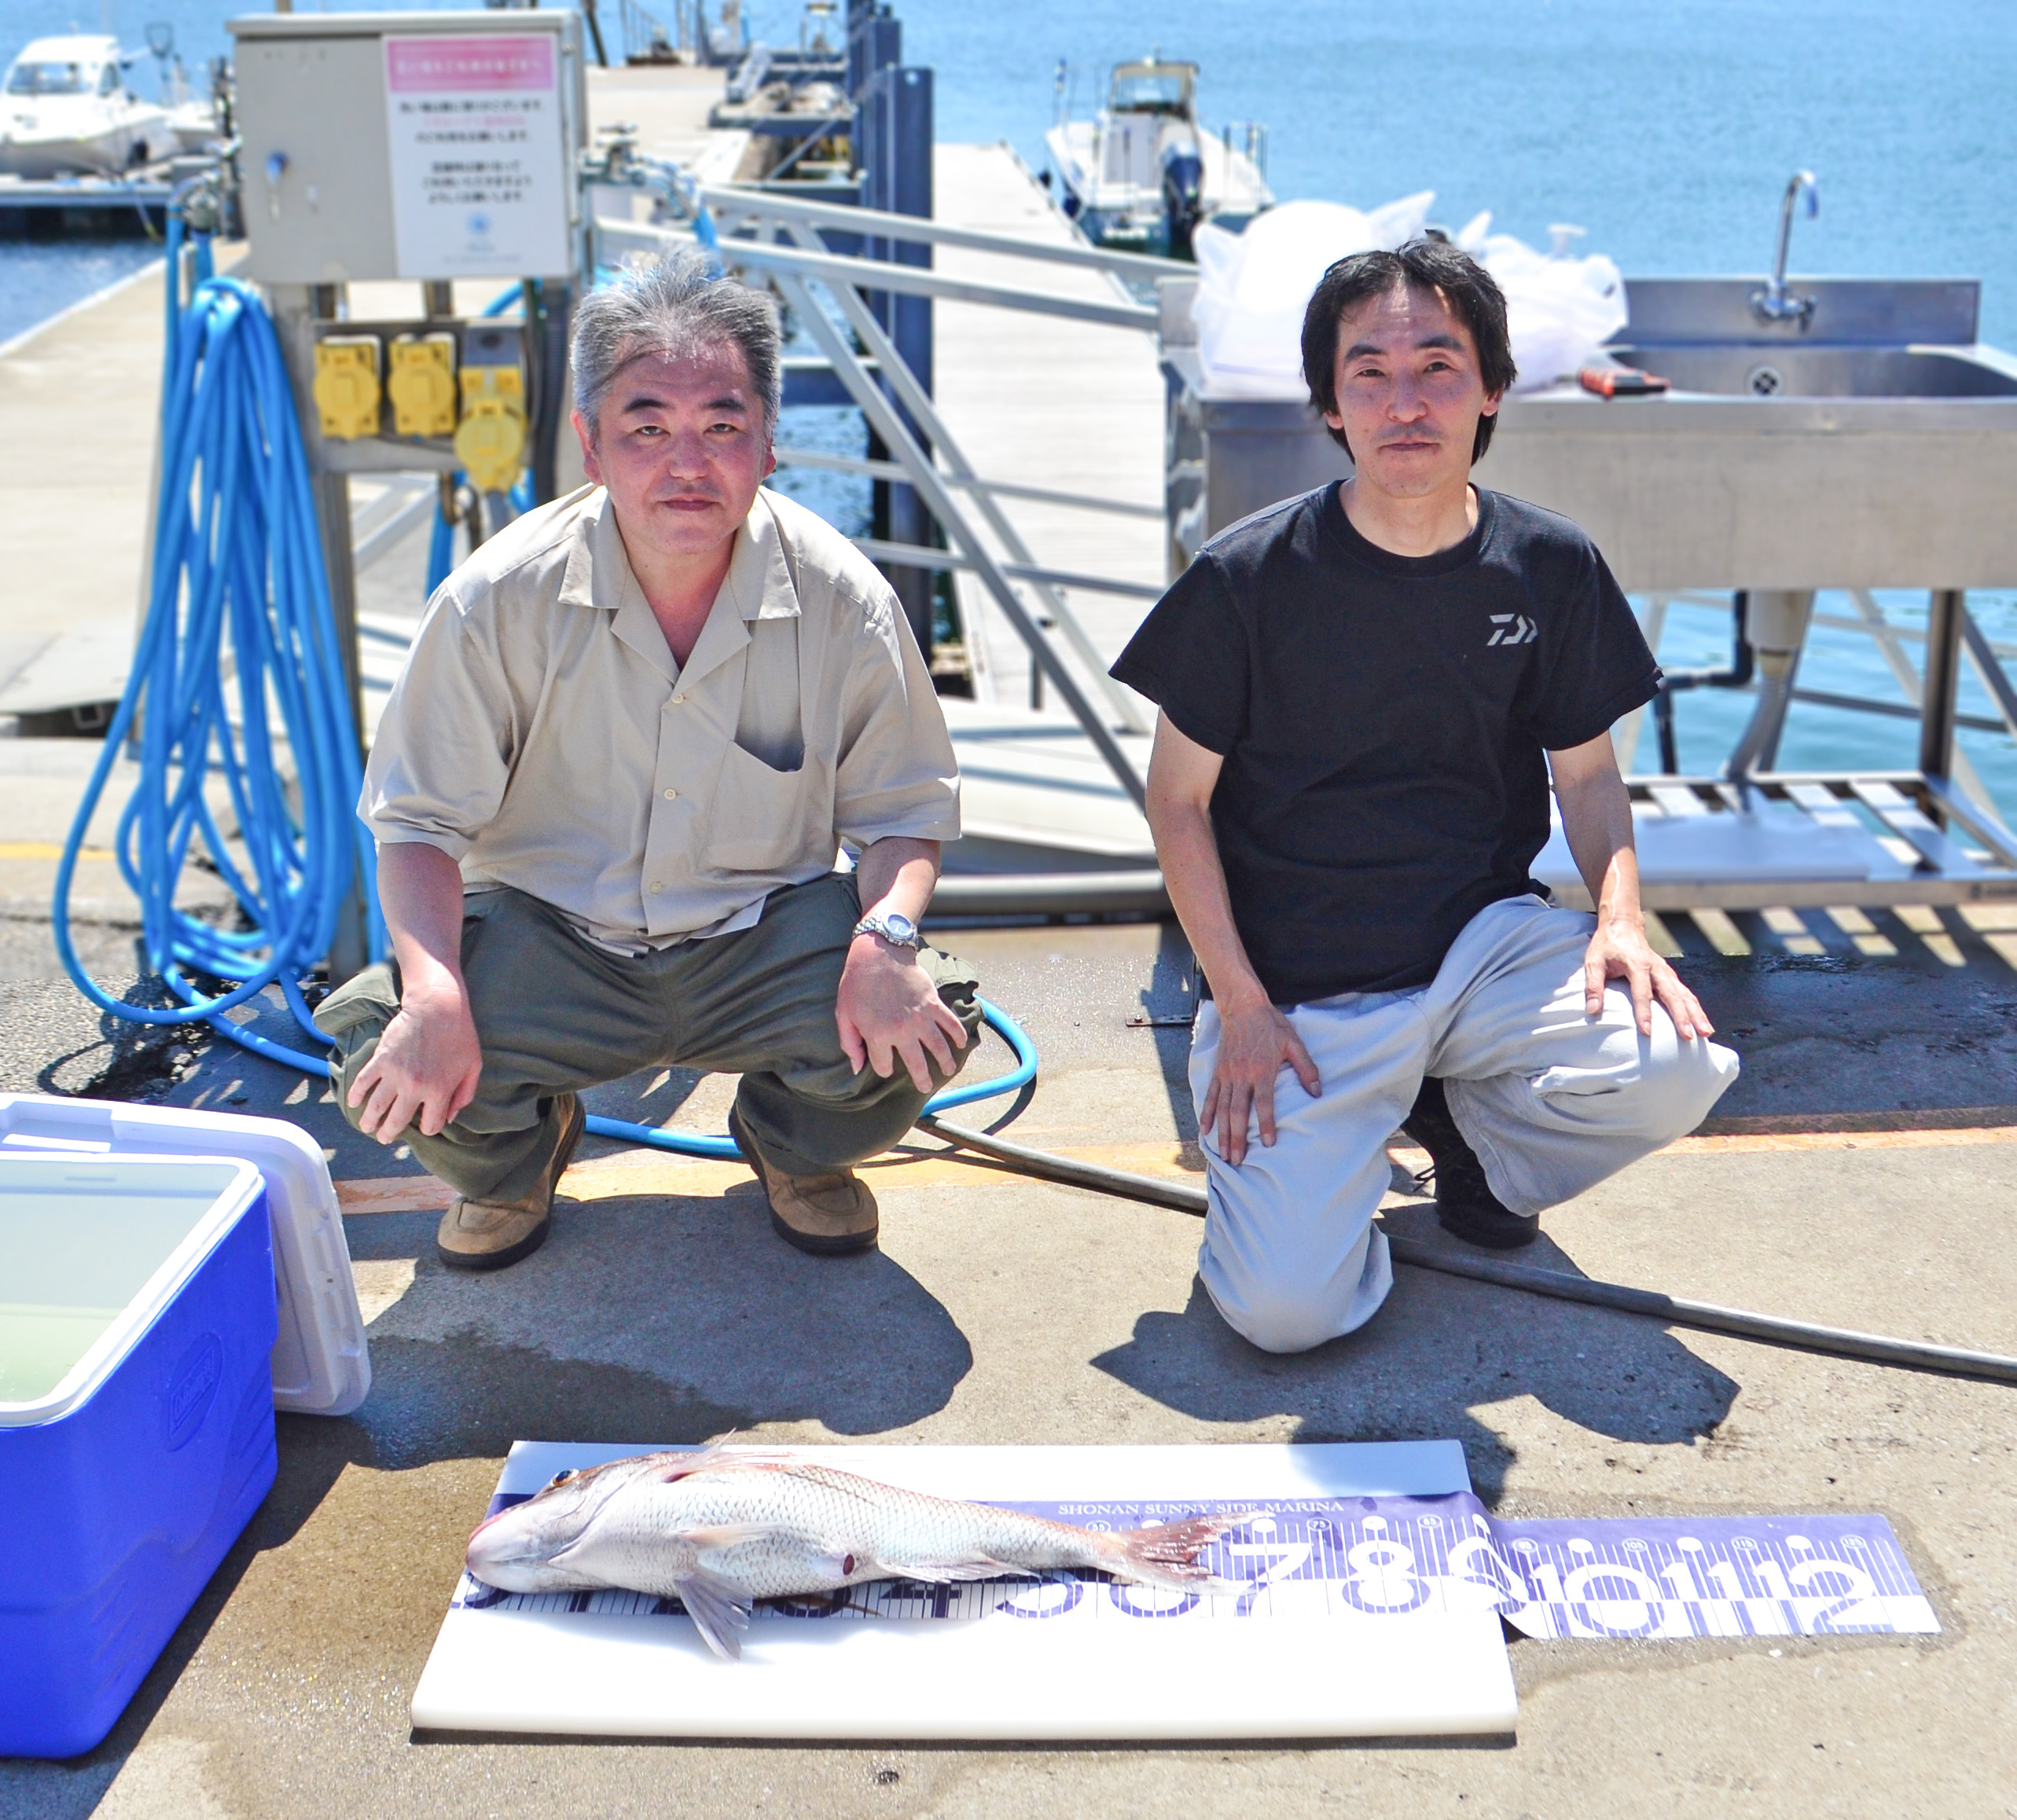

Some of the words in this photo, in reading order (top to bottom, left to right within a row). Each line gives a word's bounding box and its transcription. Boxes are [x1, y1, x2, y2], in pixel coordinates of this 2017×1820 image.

[1058, 1504, 1139, 1515] SHONAN
[1144, 1503, 1211, 1514] SUNNY
[1216, 1503, 1258, 1514] SIDE
[1265, 1501, 1344, 1513] MARINA
[1229, 1543, 1311, 1616] 7
[1342, 1540, 1431, 1614] 8
